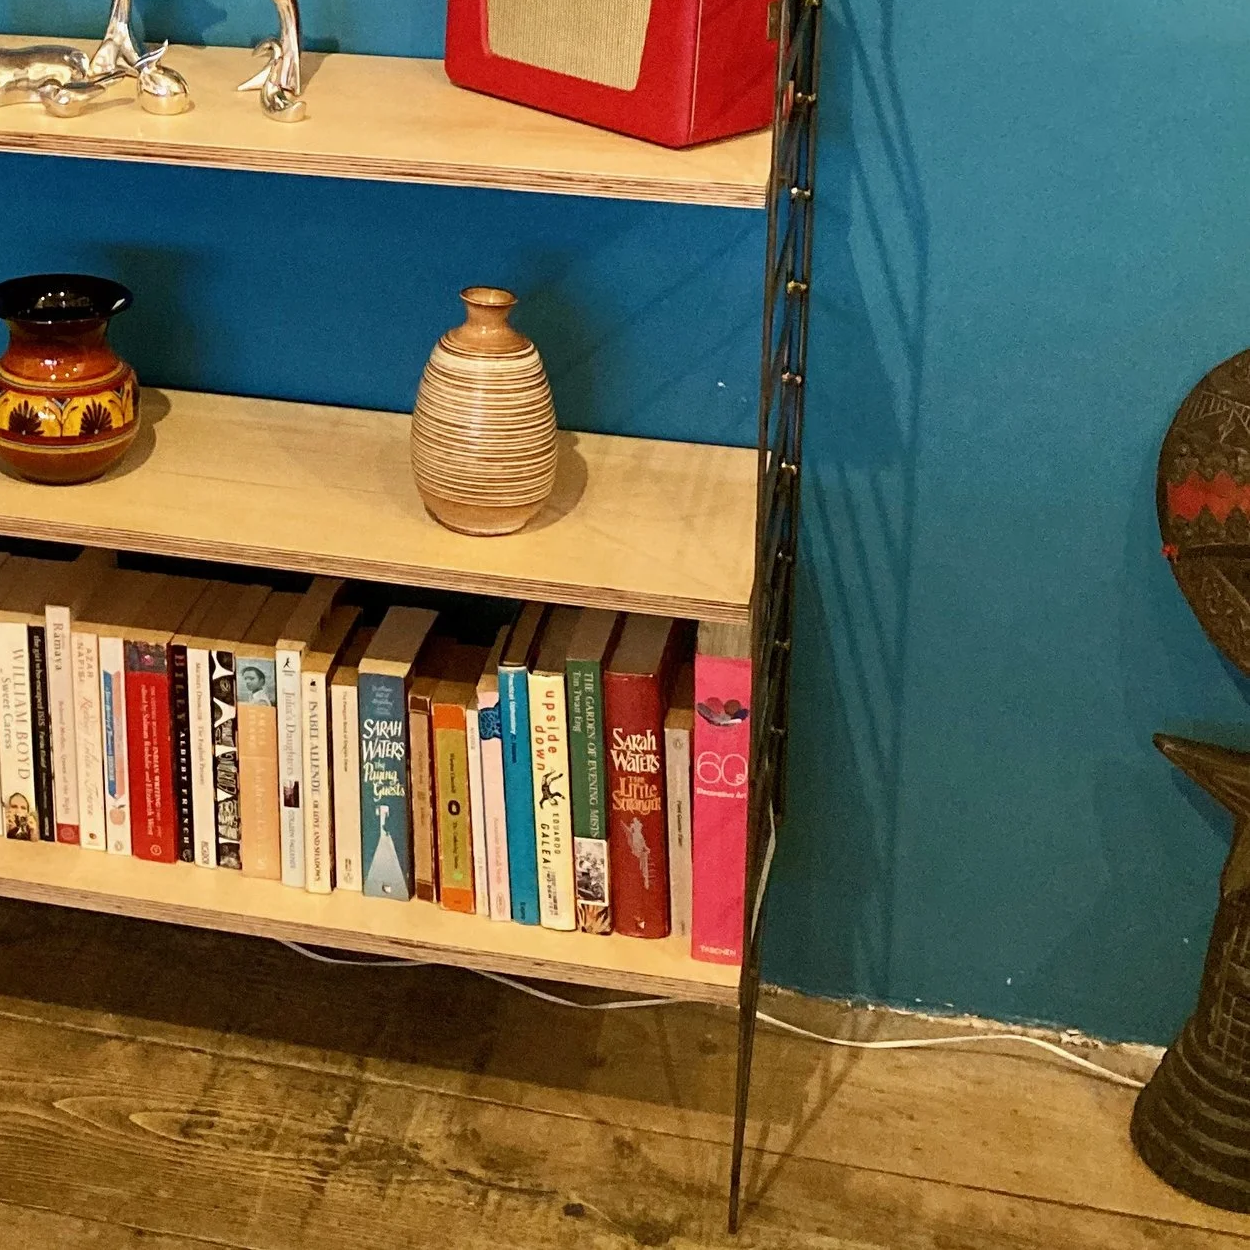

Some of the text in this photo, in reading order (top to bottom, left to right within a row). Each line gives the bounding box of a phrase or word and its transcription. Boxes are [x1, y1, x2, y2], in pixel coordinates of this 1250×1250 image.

[32, 648, 42, 662] girl
[33, 635, 41, 647] the
[85, 648, 93, 678] AZAR
[141, 684, 149, 703] edited
[173, 654, 187, 720] BILLY
[571, 671, 583, 733] Tan Twan Eng
[1, 677, 13, 750] Sweet Caress
[12, 648, 30, 780] WILLIAM BOYD
[37, 711, 46, 727] ISIS
[142, 714, 151, 739] Salman
[309, 701, 319, 739] ISABEL
[362, 718, 402, 739] SARAH
[542, 690, 560, 754] upside
[198, 739, 206, 762] English
[284, 724, 298, 776] Daughters
[362, 739, 405, 761] WATERS
[535, 725, 546, 771] down
[583, 672, 600, 838] THE GARDEN OF EVENING MISTS
[310, 741, 321, 795] ALLENDE
[363, 762, 399, 787] Paying
[696, 751, 748, 787] 60s
[153, 776, 162, 808] WRITING
[179, 731, 190, 845] ALBERT FRENCH
[373, 781, 405, 803] Guests
[696, 788, 747, 799] Decorative Art
[553, 812, 561, 856] EDUARDO
